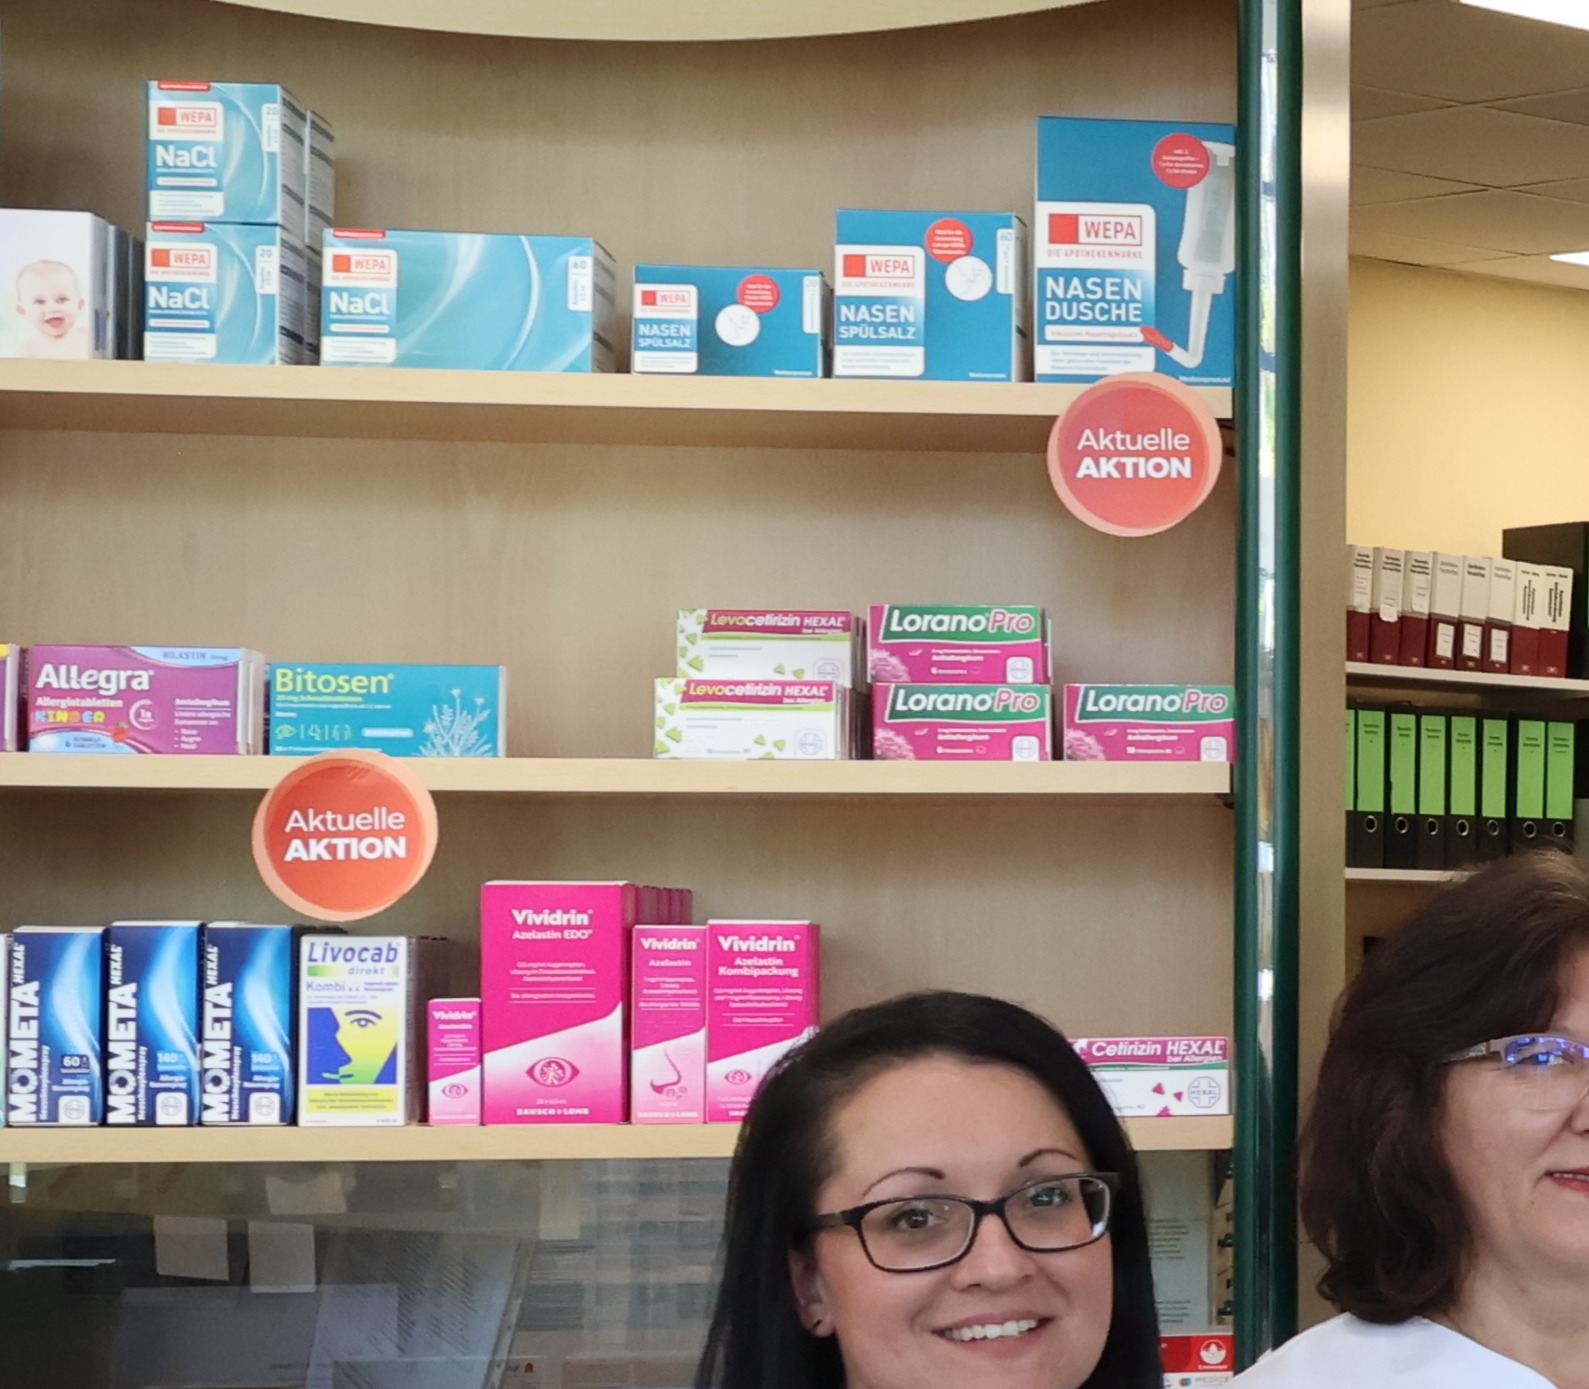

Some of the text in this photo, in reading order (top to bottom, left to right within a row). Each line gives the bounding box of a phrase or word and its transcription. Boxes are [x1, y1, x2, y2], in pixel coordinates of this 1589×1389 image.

[179, 110, 214, 126] WEPA
[155, 144, 217, 168] NaCl
[1084, 220, 1137, 240] WEPA
[172, 250, 208, 267] WEPA
[353, 255, 389, 272] WEPA
[870, 258, 911, 275] WEPA
[1045, 276, 1142, 300] NASEN
[148, 286, 210, 309] NaCl
[329, 292, 390, 316] NaCl
[840, 305, 915, 323] NASEN
[1045, 299, 1143, 322] DUSCHE
[638, 323, 691, 338] NASEN
[840, 322, 916, 340] SPÜLSALZ
[638, 335, 691, 349] SPÜLSALZ
[1077, 428, 1190, 451] Aktuelle
[1076, 457, 1192, 479] AKTION
[710, 613, 801, 627] Levocetirizin
[35, 663, 150, 695] Allegra
[275, 668, 390, 694] Bitosen
[689, 683, 782, 697] Levocetirizin
[35, 710, 105, 723] KINDER
[284, 808, 405, 832] Aktuelle
[284, 836, 407, 862] AKTION
[512, 909, 591, 926] Vividrin
[512, 930, 562, 940] Azelastin
[640, 937, 698, 950] Vividrin
[717, 935, 796, 953] Vividrin
[307, 942, 399, 964] Livocab
[348, 966, 386, 976] direkt
[718, 966, 799, 978] Kombipackung
[306, 980, 346, 992] Kombi
[9, 981, 40, 1122] MOMETA
[108, 982, 137, 1123] MOMETA
[202, 982, 233, 1123] MOMETA
[1092, 1040, 1223, 1058] Cetirizin HEXAL
[63, 1056, 80, 1067] 60
